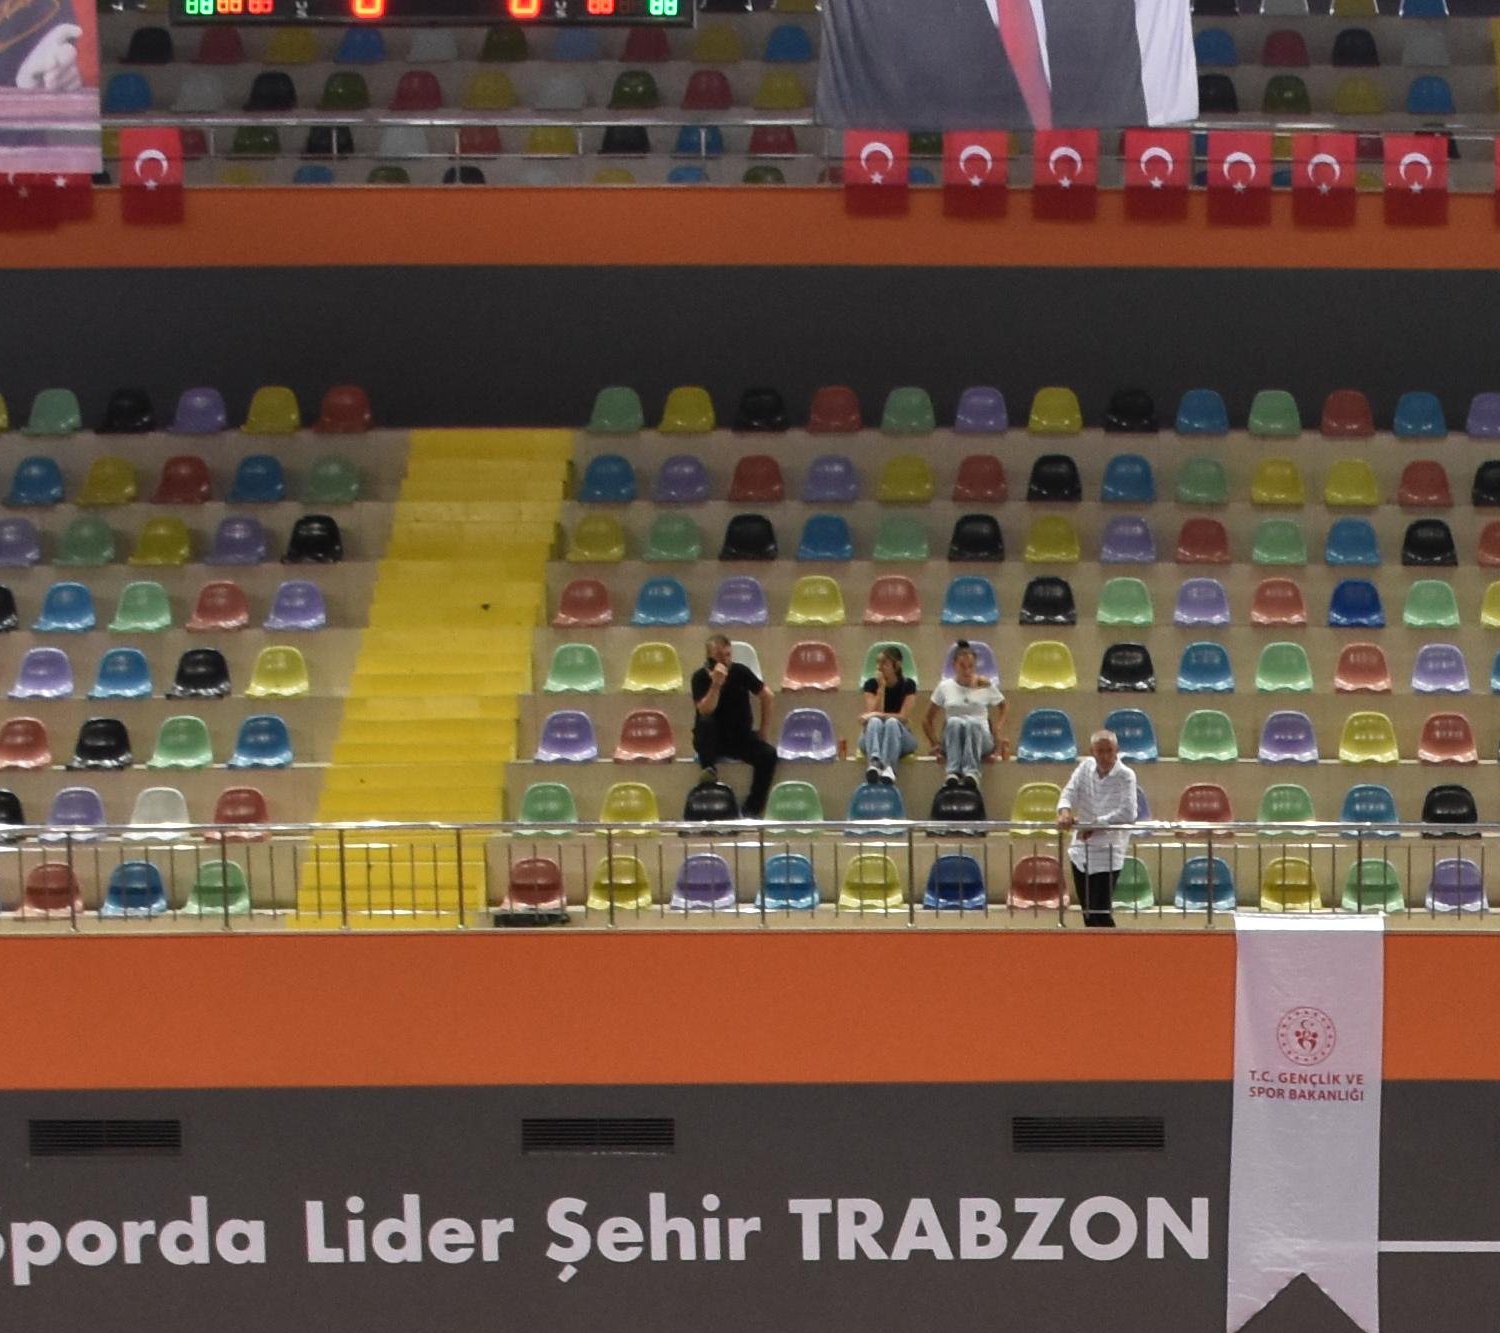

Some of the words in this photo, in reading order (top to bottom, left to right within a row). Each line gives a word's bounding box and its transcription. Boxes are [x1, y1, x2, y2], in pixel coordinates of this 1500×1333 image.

[1249, 1070, 1274, 1083] T.C.
[1278, 1070, 1341, 1088] GENÇLİK
[1345, 1073, 1364, 1086] VE
[1249, 1086, 1285, 1100] SPOR
[1288, 1087, 1365, 1102] BAKANLIĞI
[305, 1193, 515, 1265] Lider
[546, 1192, 761, 1283] Şehir
[789, 1195, 1210, 1262] TRABZON
